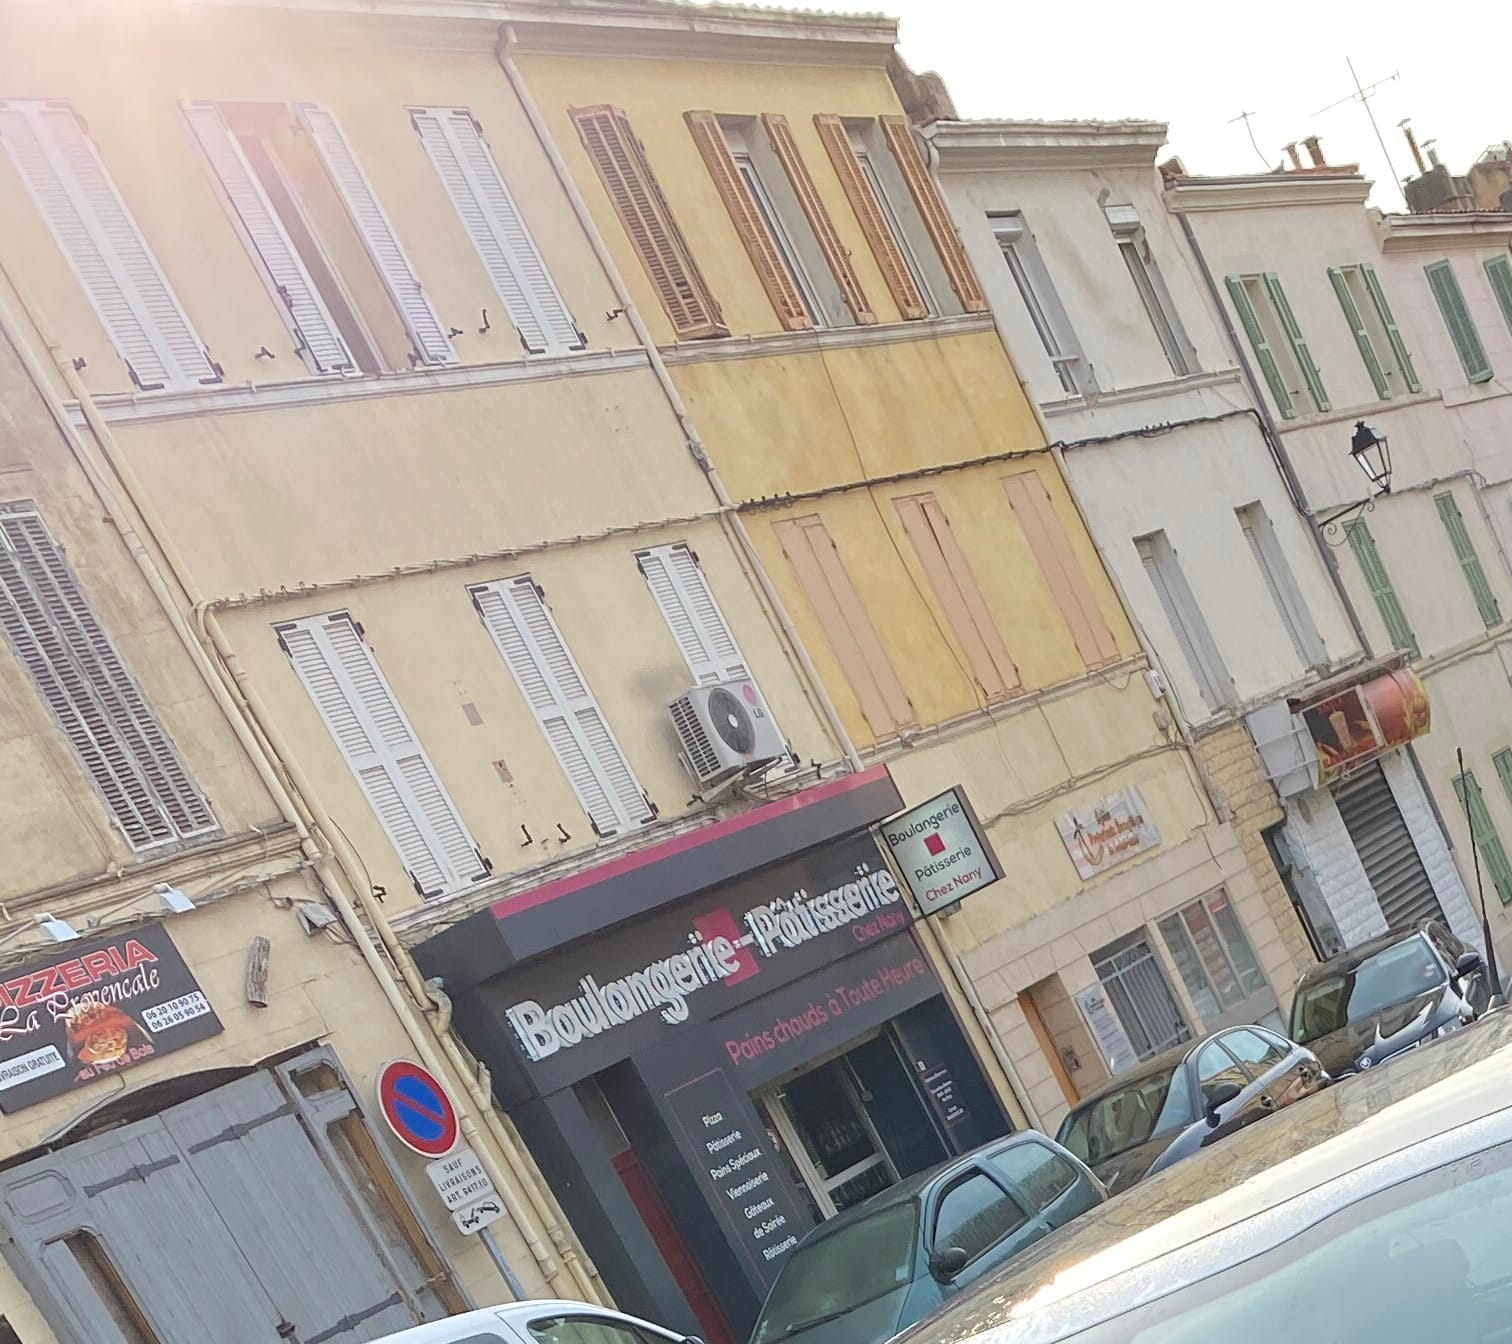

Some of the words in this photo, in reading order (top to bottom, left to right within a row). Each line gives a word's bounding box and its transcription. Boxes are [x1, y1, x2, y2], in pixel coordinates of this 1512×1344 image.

[888, 803, 960, 847] Boulangerie
[914, 846, 972, 881] Pâtisserie
[926, 883, 954, 902] Chez
[952, 867, 984, 888] Nany
[145, 1009, 158, 1021] 06
[157, 1004, 169, 1015] 20
[167, 1000, 180, 1011] 10
[189, 993, 200, 1003] 75
[151, 1020, 163, 1030] 06
[183, 1007, 196, 1017] 90
[194, 1003, 206, 1013] 54
[725, 1028, 776, 1066] Pains
[773, 1002, 829, 1044] chauds
[834, 976, 884, 1009] Toute
[878, 958, 926, 993] Heure
[0, 1060, 29, 1081] VRAISON
[27, 1051, 60, 1071] GRATUITE
[702, 1112, 723, 1127] Pizza
[706, 1129, 742, 1154] Pâtisserie
[439, 1165, 483, 1192] LIVRAISONS
[443, 1158, 462, 1174] SAUF
[710, 1164, 733, 1180] Pains
[726, 1171, 769, 1200] Viennoiserie
[744, 1197, 776, 1219] Gâteaux
